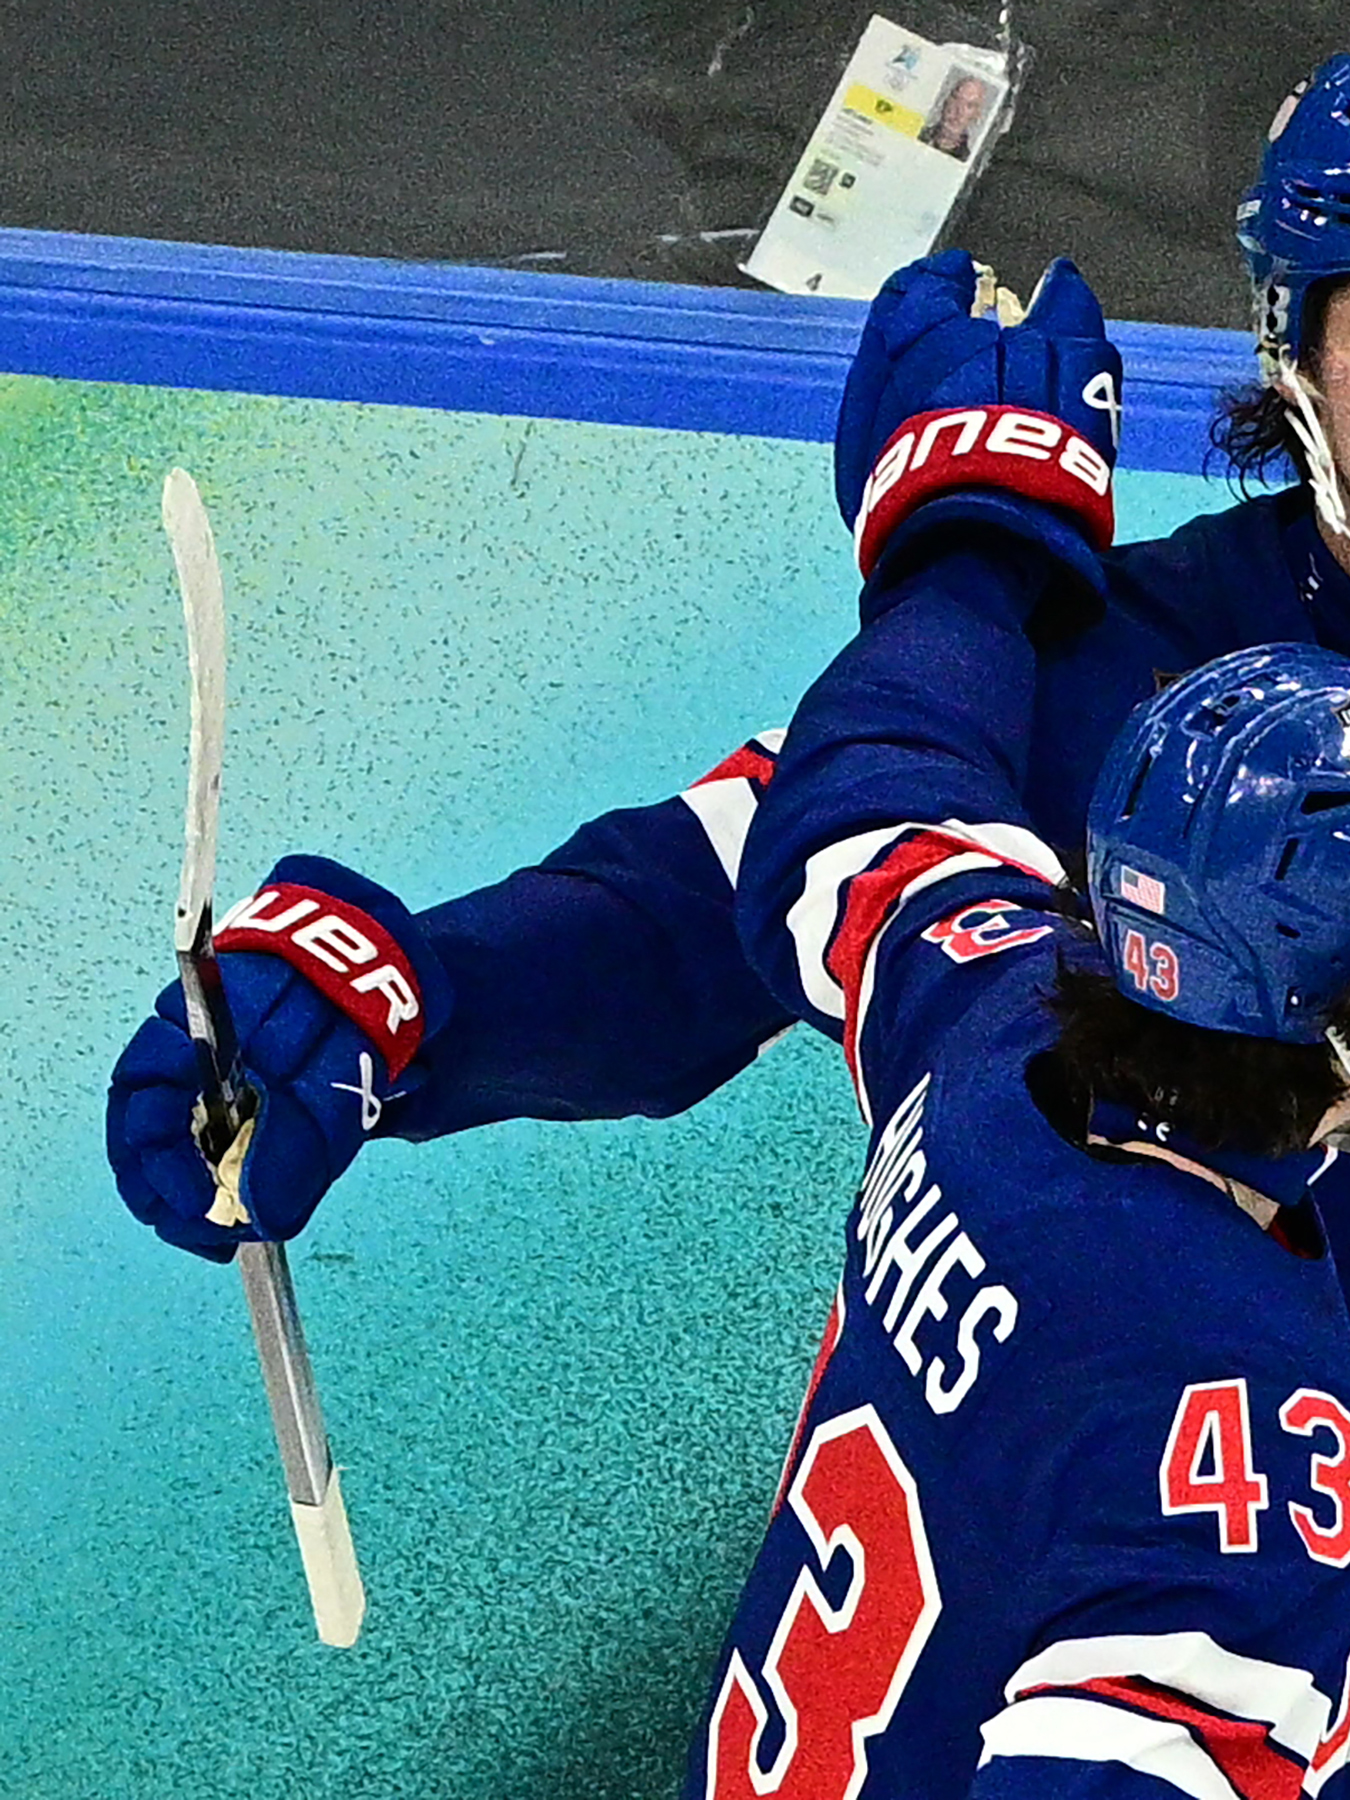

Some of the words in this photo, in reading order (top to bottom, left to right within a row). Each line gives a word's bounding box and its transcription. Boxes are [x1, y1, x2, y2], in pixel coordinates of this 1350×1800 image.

[1122, 928, 1180, 1002] 43
[856, 1072, 1019, 1415] HUGHES
[703, 1402, 943, 1800] 3
